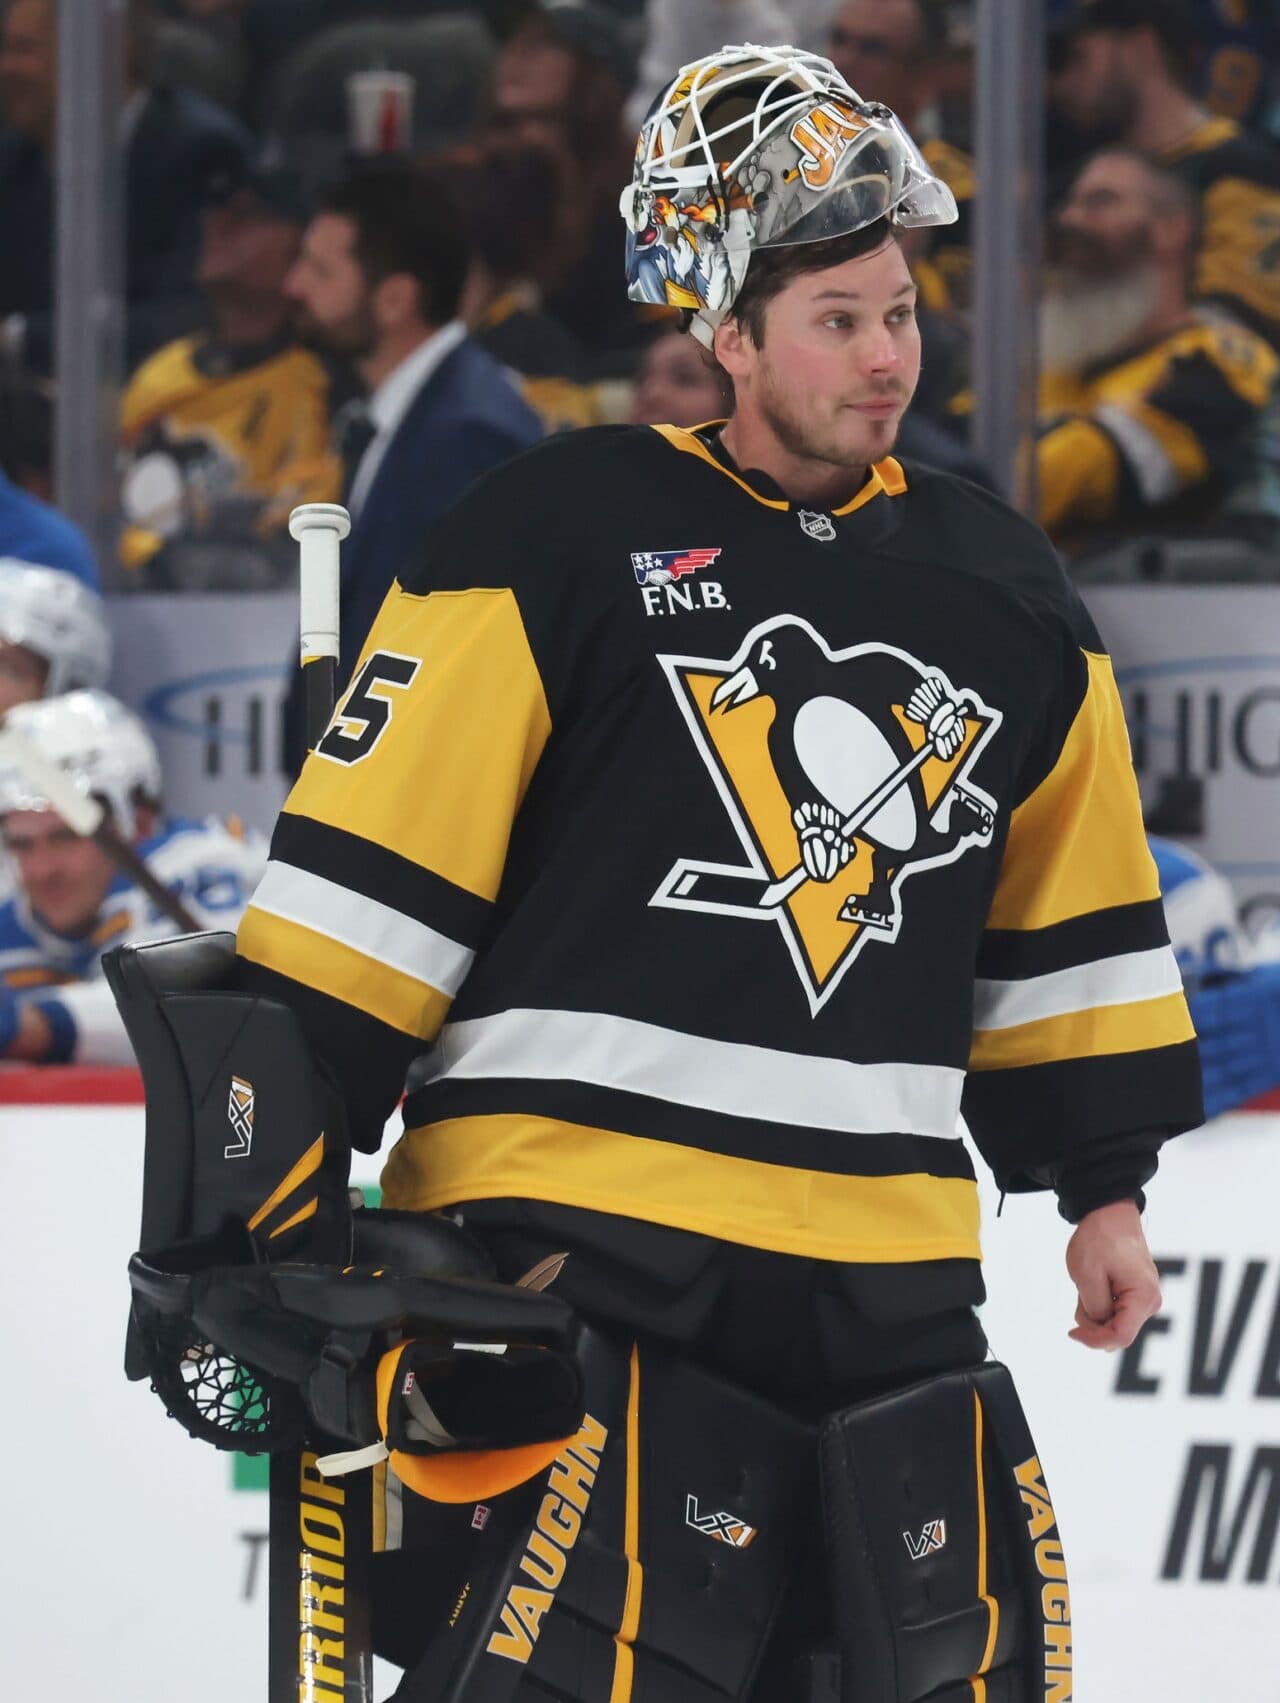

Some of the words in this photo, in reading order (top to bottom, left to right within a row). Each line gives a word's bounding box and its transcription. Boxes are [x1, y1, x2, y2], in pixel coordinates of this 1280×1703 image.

[641, 581, 732, 617] F.N.B.
[314, 649, 424, 768] 5
[485, 1412, 609, 1665] VAUGHN
